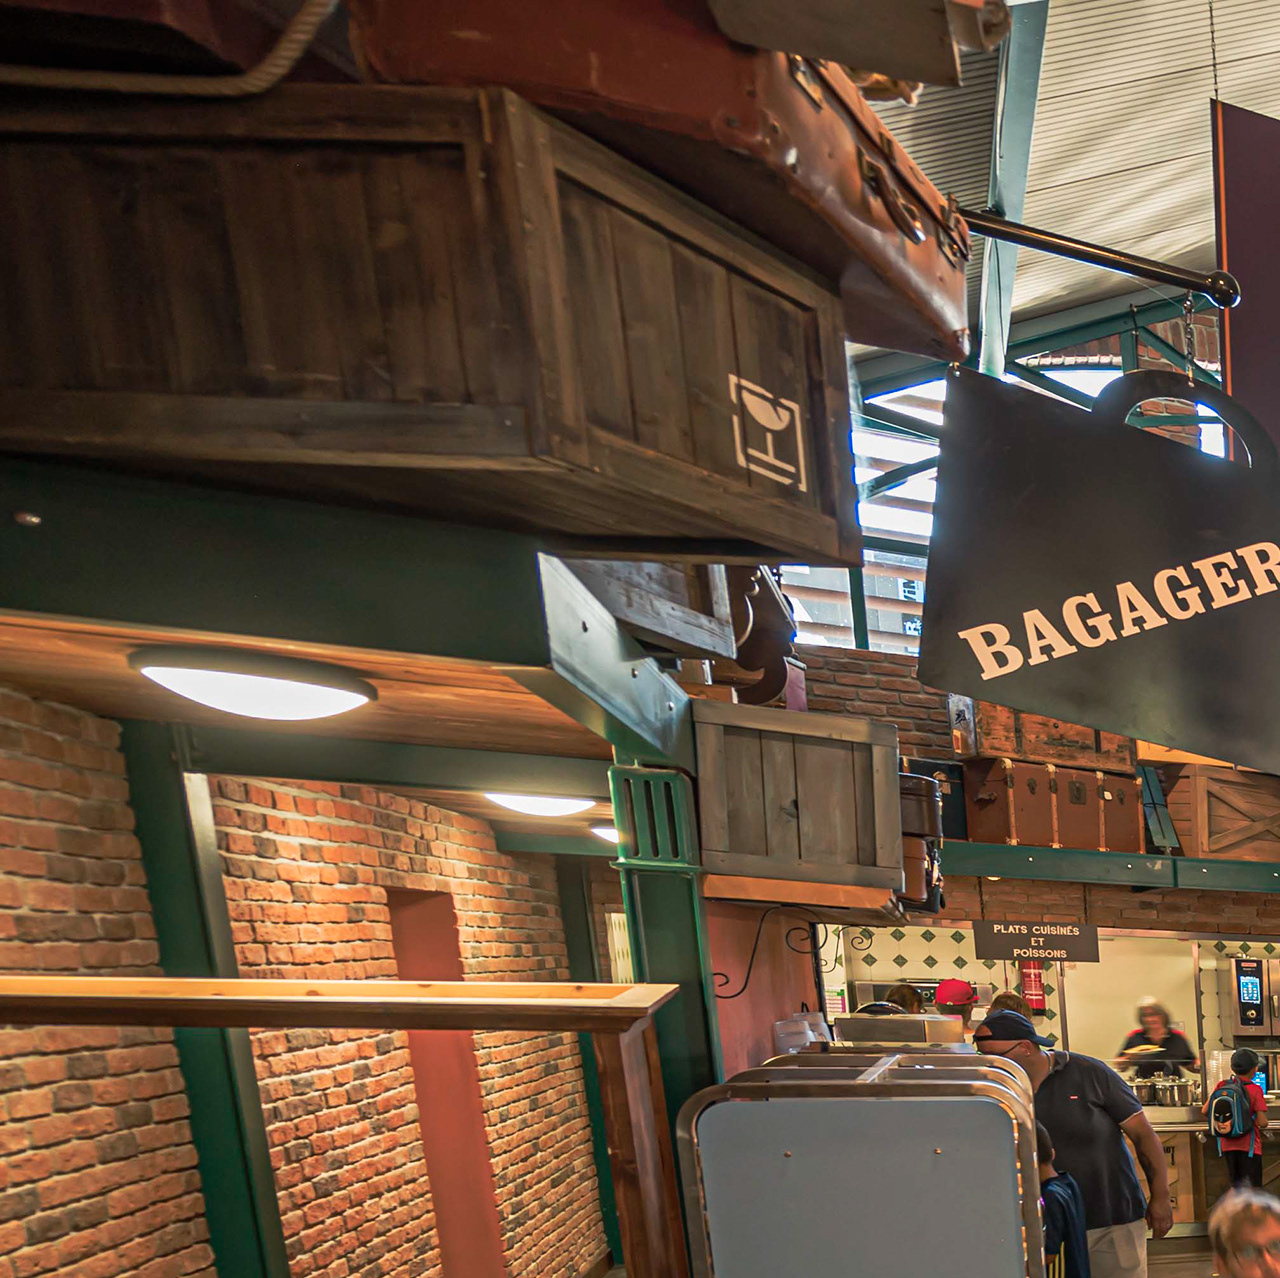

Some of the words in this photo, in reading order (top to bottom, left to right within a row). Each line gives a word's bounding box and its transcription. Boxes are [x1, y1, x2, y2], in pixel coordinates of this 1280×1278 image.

[993, 925, 1028, 934] PLATS
[1032, 925, 1080, 936] CUISINÉS
[1030, 938, 1045, 946] ET
[1013, 948, 1068, 958] POISSONS
